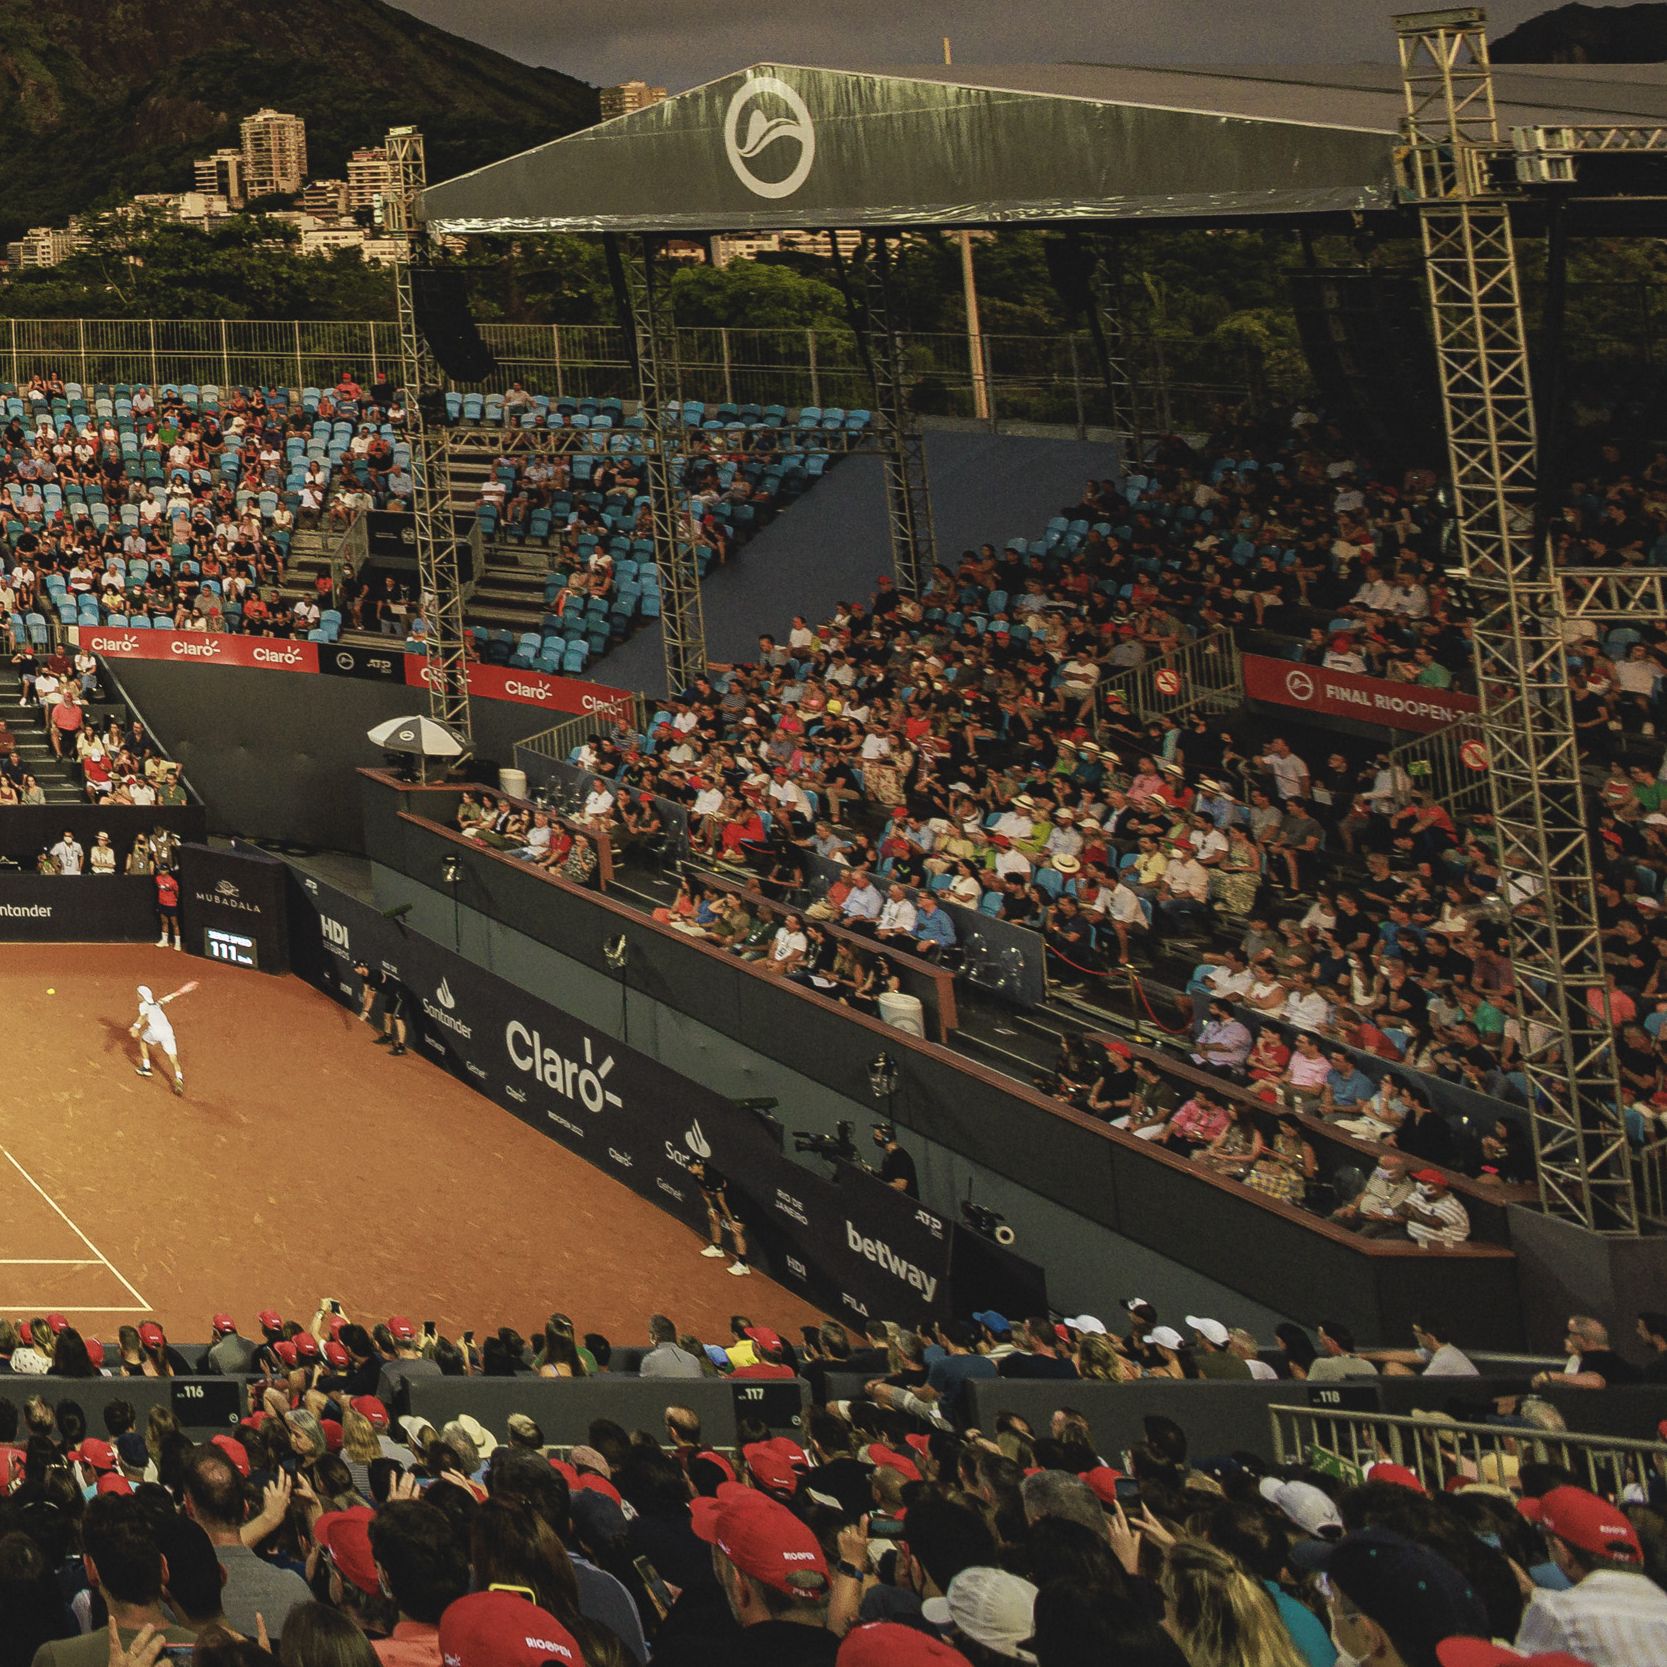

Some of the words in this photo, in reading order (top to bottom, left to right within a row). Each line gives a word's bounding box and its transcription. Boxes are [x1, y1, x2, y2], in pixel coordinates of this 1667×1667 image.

[91, 636, 131, 652] Claro
[171, 640, 212, 657] Claro
[253, 646, 295, 665] Claro
[366, 659, 392, 669] ATP
[505, 680, 545, 700] Claro
[1325, 684, 1372, 707] FINAL
[196, 892, 262, 914] MUBADALA
[320, 913, 349, 949] HDI
[210, 940, 237, 962] 111
[322, 939, 350, 961] SEGUROS
[422, 997, 472, 1040] Santander
[506, 1020, 604, 1113] Claro
[505, 1084, 525, 1103] Claro
[776, 1188, 790, 1203] RIO
[792, 1196, 804, 1212] DE
[774, 1199, 809, 1226] JANEIRO
[914, 1209, 943, 1231] ATP
[786, 1254, 807, 1277] HDI
[845, 1220, 938, 1303] betway
[841, 1292, 870, 1318] FILA
[184, 1385, 204, 1398] 116
[745, 1388, 764, 1400] 117
[1319, 1391, 1341, 1403] 118
